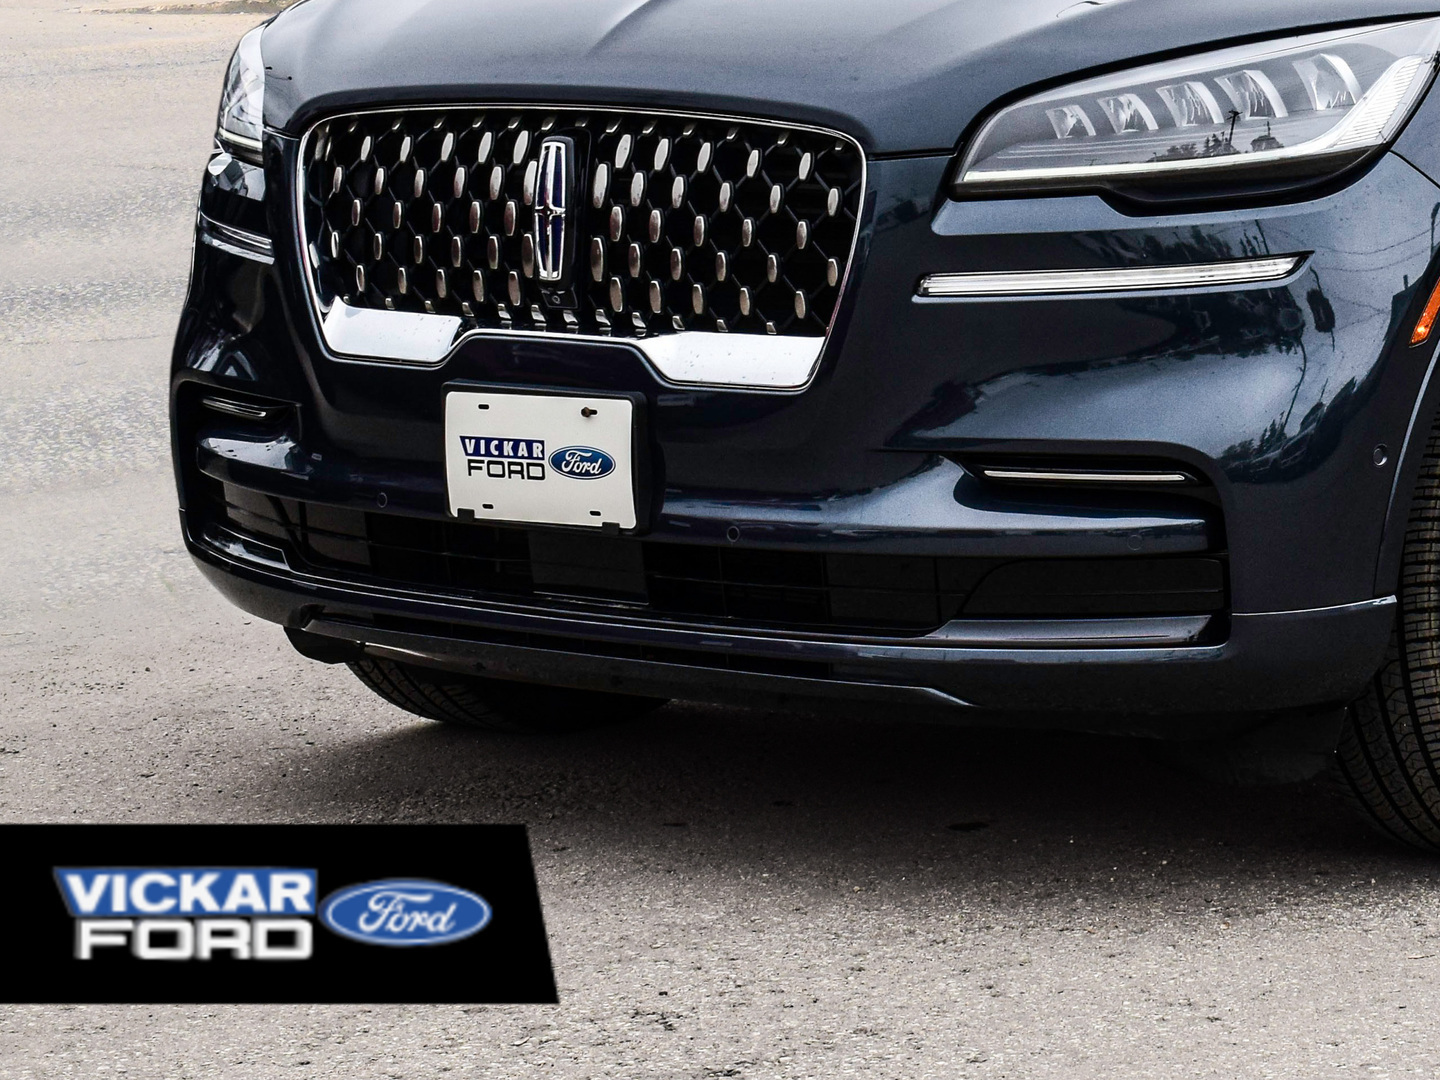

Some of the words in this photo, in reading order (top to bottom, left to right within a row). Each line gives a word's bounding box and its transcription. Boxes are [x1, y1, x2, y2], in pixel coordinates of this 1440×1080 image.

[464, 438, 544, 458] VICKAR
[467, 459, 545, 480] FORD
[561, 450, 602, 474] Ford
